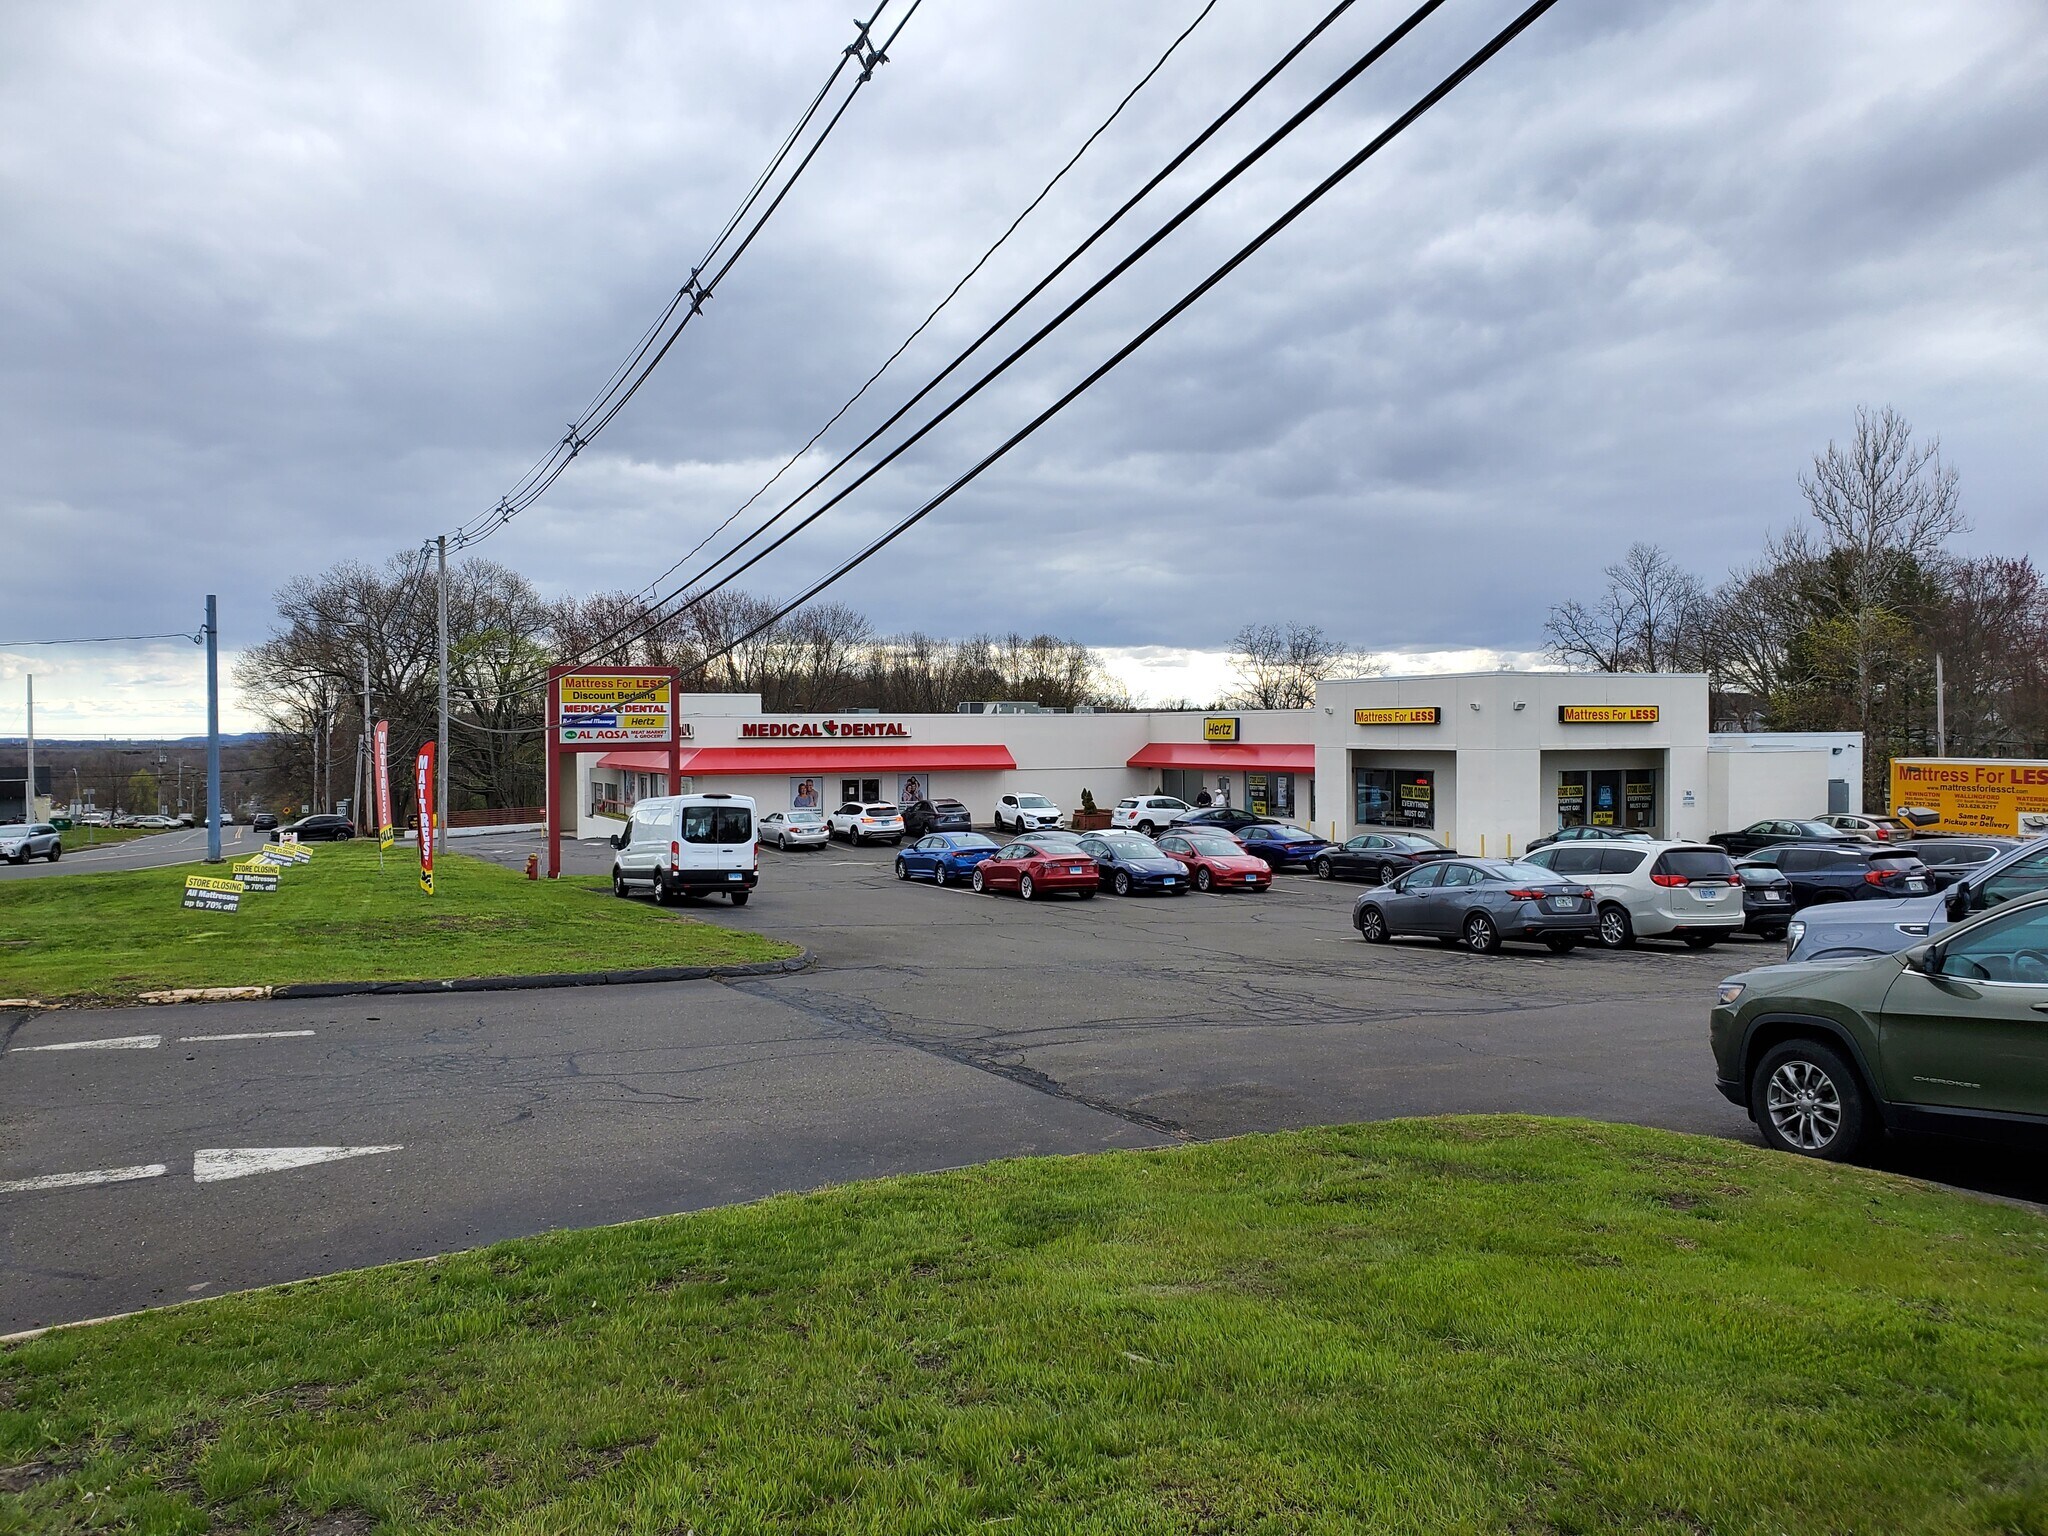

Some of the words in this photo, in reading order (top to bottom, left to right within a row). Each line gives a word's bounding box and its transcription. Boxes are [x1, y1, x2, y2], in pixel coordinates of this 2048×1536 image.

[565, 678, 613, 689] Mattress
[616, 679, 632, 689] For
[636, 679, 664, 689] LESS
[572, 691, 615, 700] Discount
[564, 705, 614, 713] MEDICAL
[624, 704, 667, 713] DENTAL
[1565, 708, 1609, 720] Mattress
[1612, 709, 1626, 720] For
[1630, 709, 1656, 720] LESS
[631, 717, 655, 726] Hertz
[1356, 711, 1392, 722] Mattress
[1394, 711, 1407, 721] For
[1410, 711, 1434, 721] LESS
[577, 730, 593, 739] AL
[596, 730, 629, 739] AQSA
[742, 723, 822, 736] MEDICAL
[841, 723, 907, 736] DENTAL
[1208, 723, 1231, 735] Hertz
[378, 731, 387, 825] MATTRESS
[1899, 765, 1969, 783] Mattress
[1976, 767, 2004, 784] For
[1401, 786, 1414, 797] STORE
[1414, 787, 1430, 799] CLOSING
[1557, 786, 1568, 796] STORE
[1569, 786, 1583, 796] CLOSING
[1627, 785, 1638, 793] STORE
[1638, 785, 1652, 793] CLOSING
[1954, 793, 2000, 801] WALLINGFORD
[1401, 799, 1429, 808] EVERYTHING
[1404, 809, 1417, 817] MUST
[1418, 810, 1426, 818] GO!
[1958, 812, 1978, 820] Same
[1980, 814, 1994, 822] Day
[1944, 818, 1968, 826] Pickup
[1980, 821, 2010, 830] Delivery
[380, 827, 393, 844] SALE
[264, 845, 277, 853] STORE
[277, 848, 295, 857] CLOSING
[234, 865, 252, 873] STORE
[254, 866, 278, 874] CLOSING
[244, 875, 277, 883] Mattresses
[188, 878, 210, 888] STORE
[212, 880, 242, 892] CLOSING
[186, 889, 197, 897] All
[198, 890, 239, 902] Mattresses
[195, 900, 204, 908] to
[205, 901, 222, 910] 70%
[223, 903, 237, 911] off!
[1913, 1076, 1981, 1089] CHEROKEE
